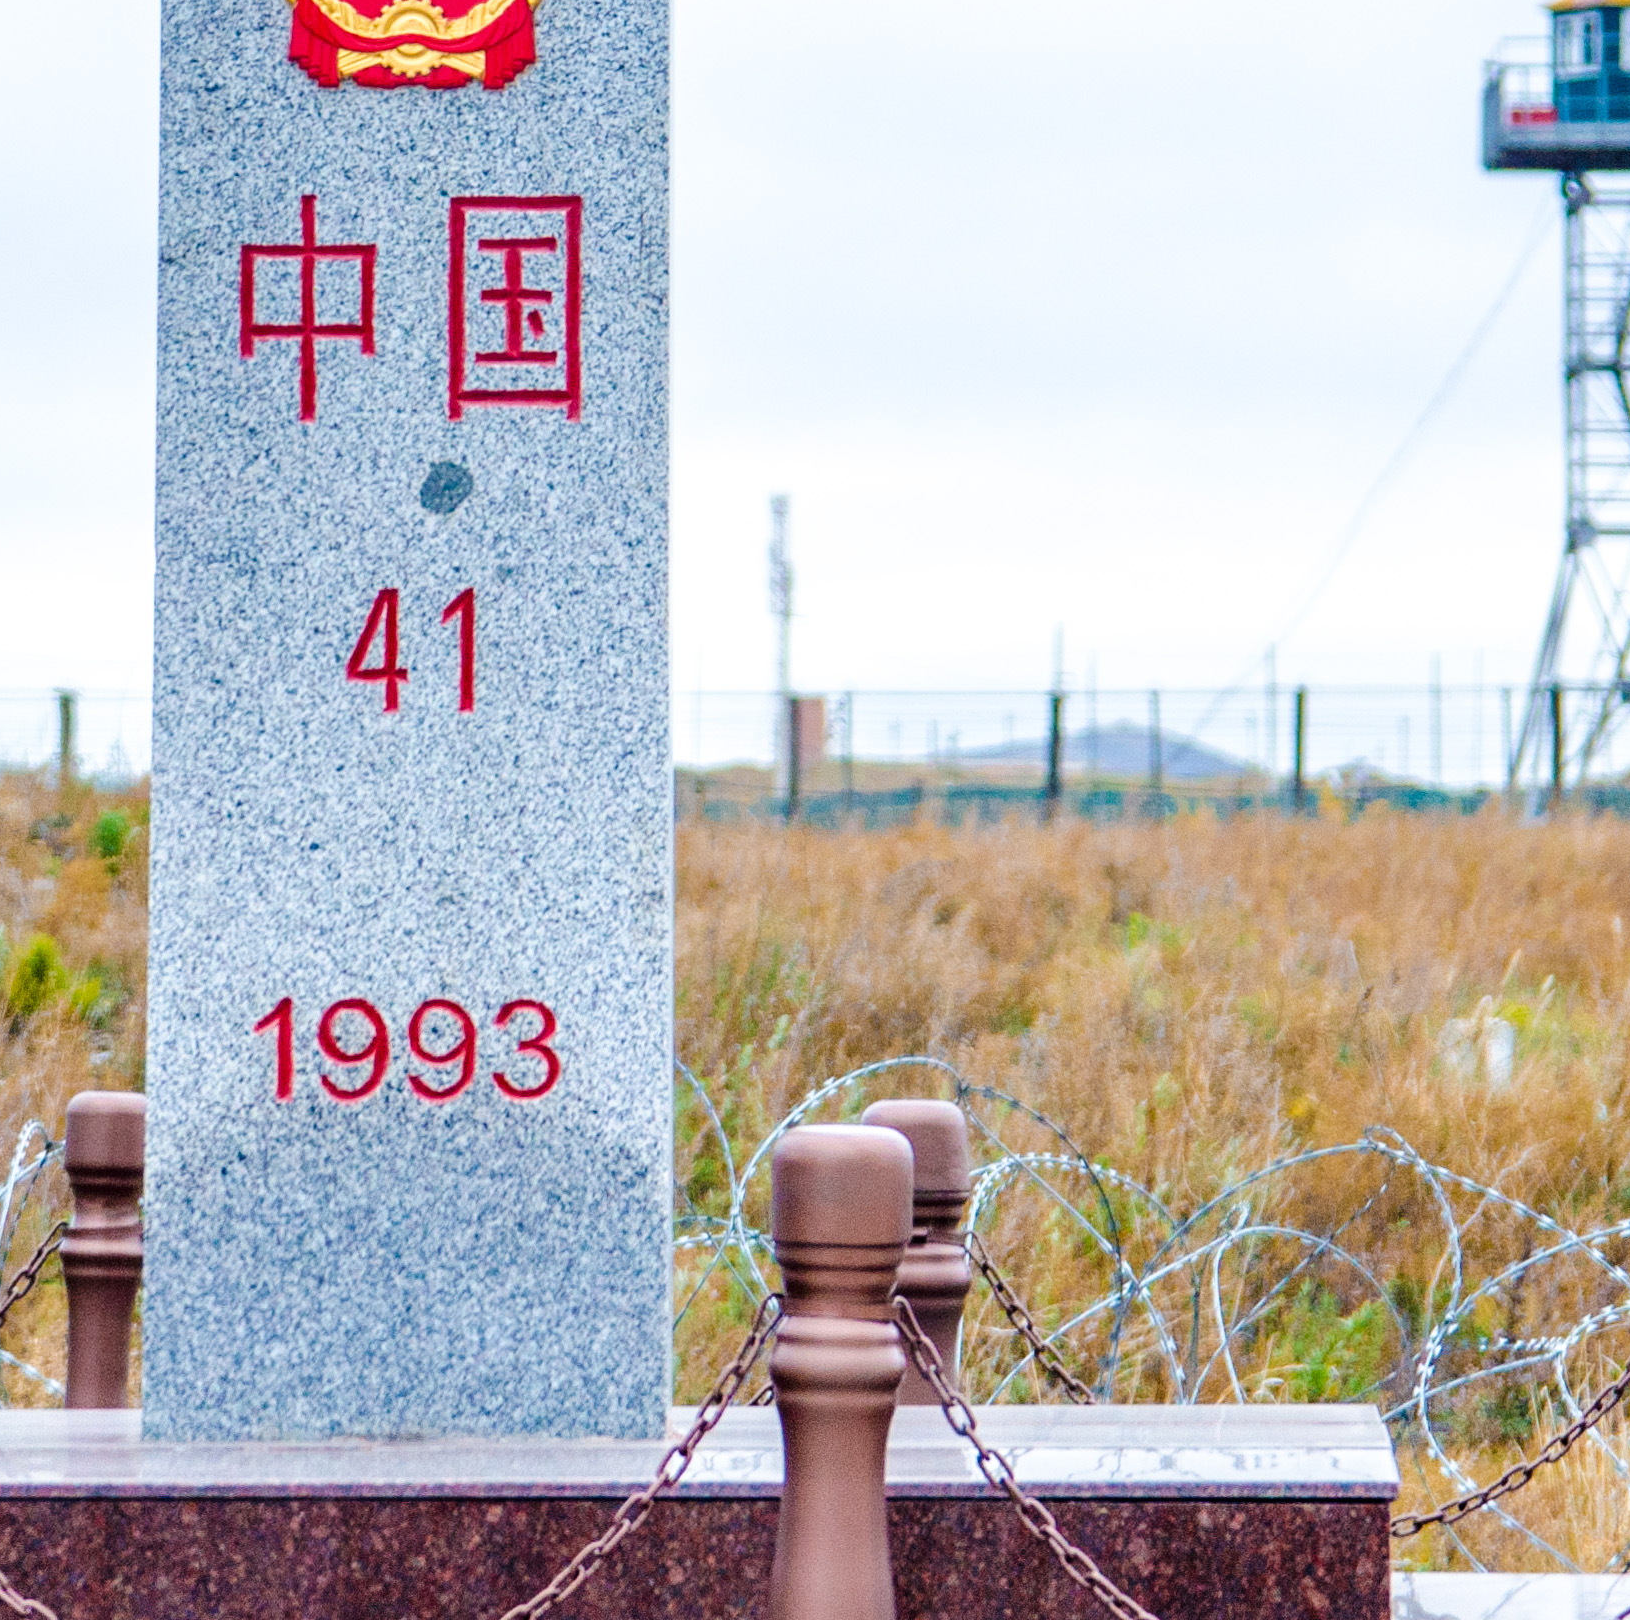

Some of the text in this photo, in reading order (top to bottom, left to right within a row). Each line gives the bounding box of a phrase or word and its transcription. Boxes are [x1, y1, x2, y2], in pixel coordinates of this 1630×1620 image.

[239, 195, 583, 422] 中国
[347, 589, 476, 713] 41
[254, 998, 561, 1103] 1993
